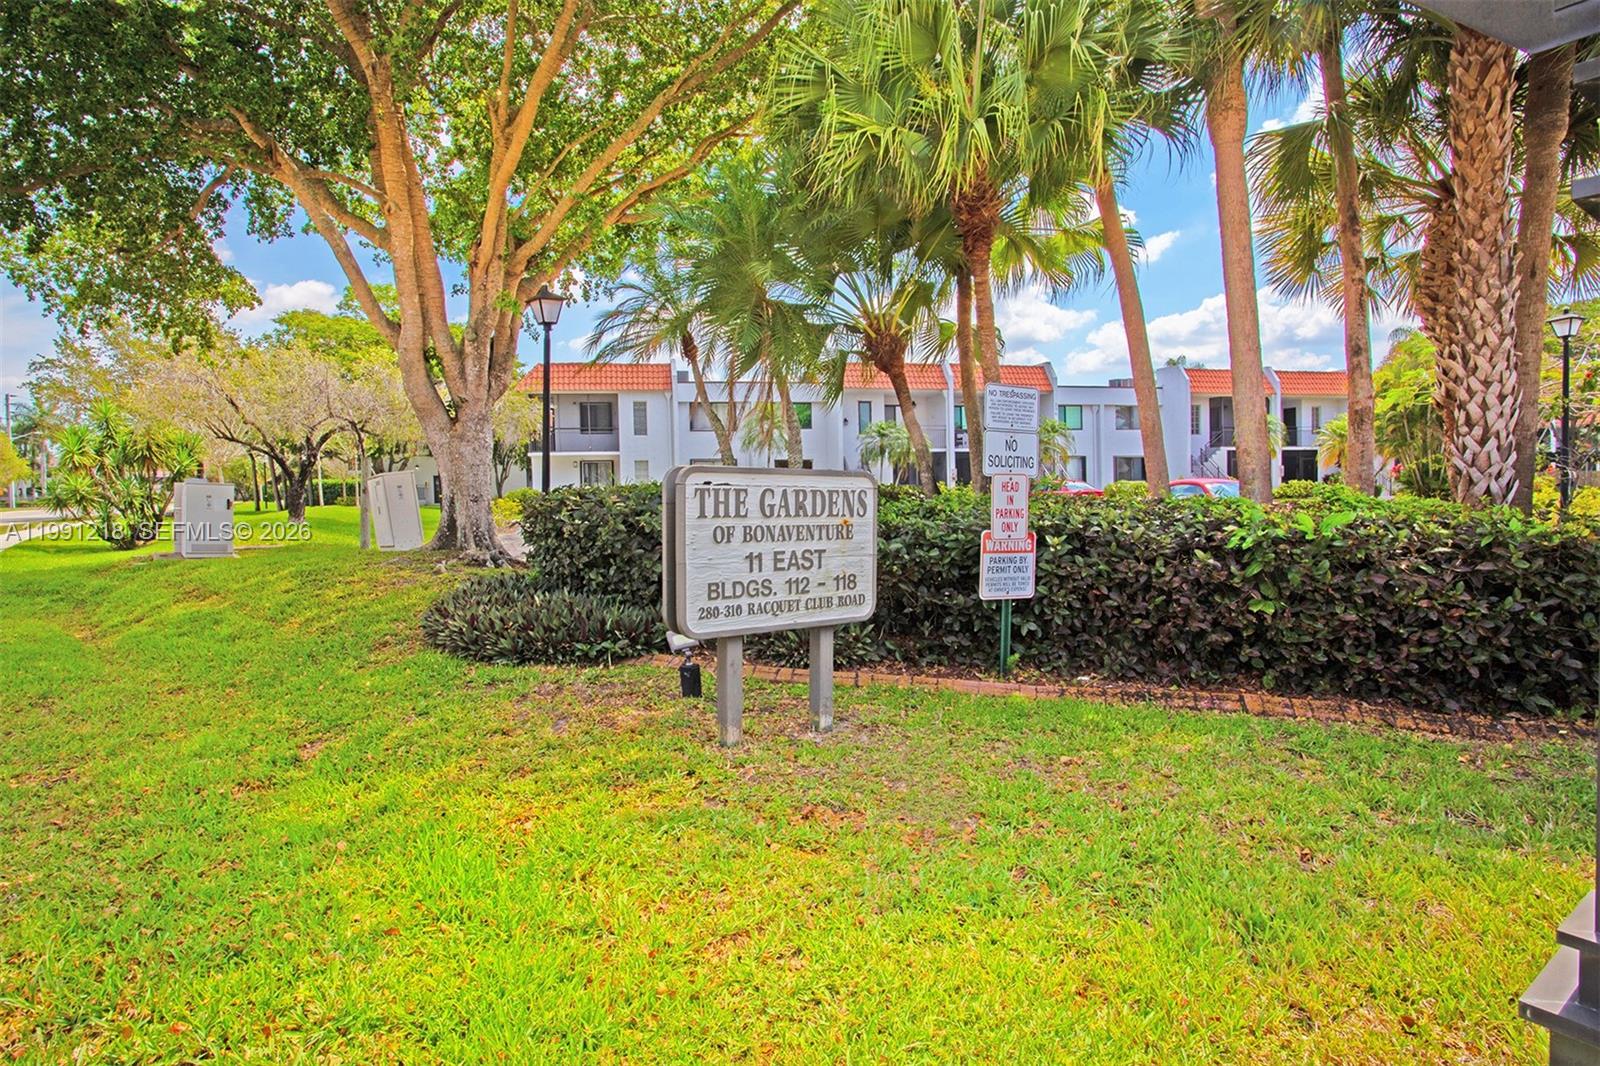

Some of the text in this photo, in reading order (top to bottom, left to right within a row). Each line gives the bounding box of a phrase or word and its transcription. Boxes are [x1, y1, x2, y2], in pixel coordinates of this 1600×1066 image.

[988, 389, 1036, 400] NO TRESPASSING
[1005, 439, 1018, 452] NO
[987, 454, 1034, 469] SOLICITING
[1001, 481, 1020, 493] HEAD
[694, 488, 867, 519] THE GARDENS
[1006, 495, 1014, 505] IN
[995, 508, 1025, 519] PARKING
[712, 523, 853, 544] OF BONAVENTURE
[1001, 522, 1019, 533] ONLY
[985, 539, 1032, 552] WARNING
[745, 549, 827, 573] 11 EAST
[989, 556, 1027, 565] PARKING BY
[987, 565, 1029, 575] PERMIT ONLY
[707, 579, 777, 601] BLDGS.
[785, 577, 810, 595] 112
[833, 574, 857, 592] 118
[697, 593, 866, 621] 280-310 RACQUET CLUB ROAD
